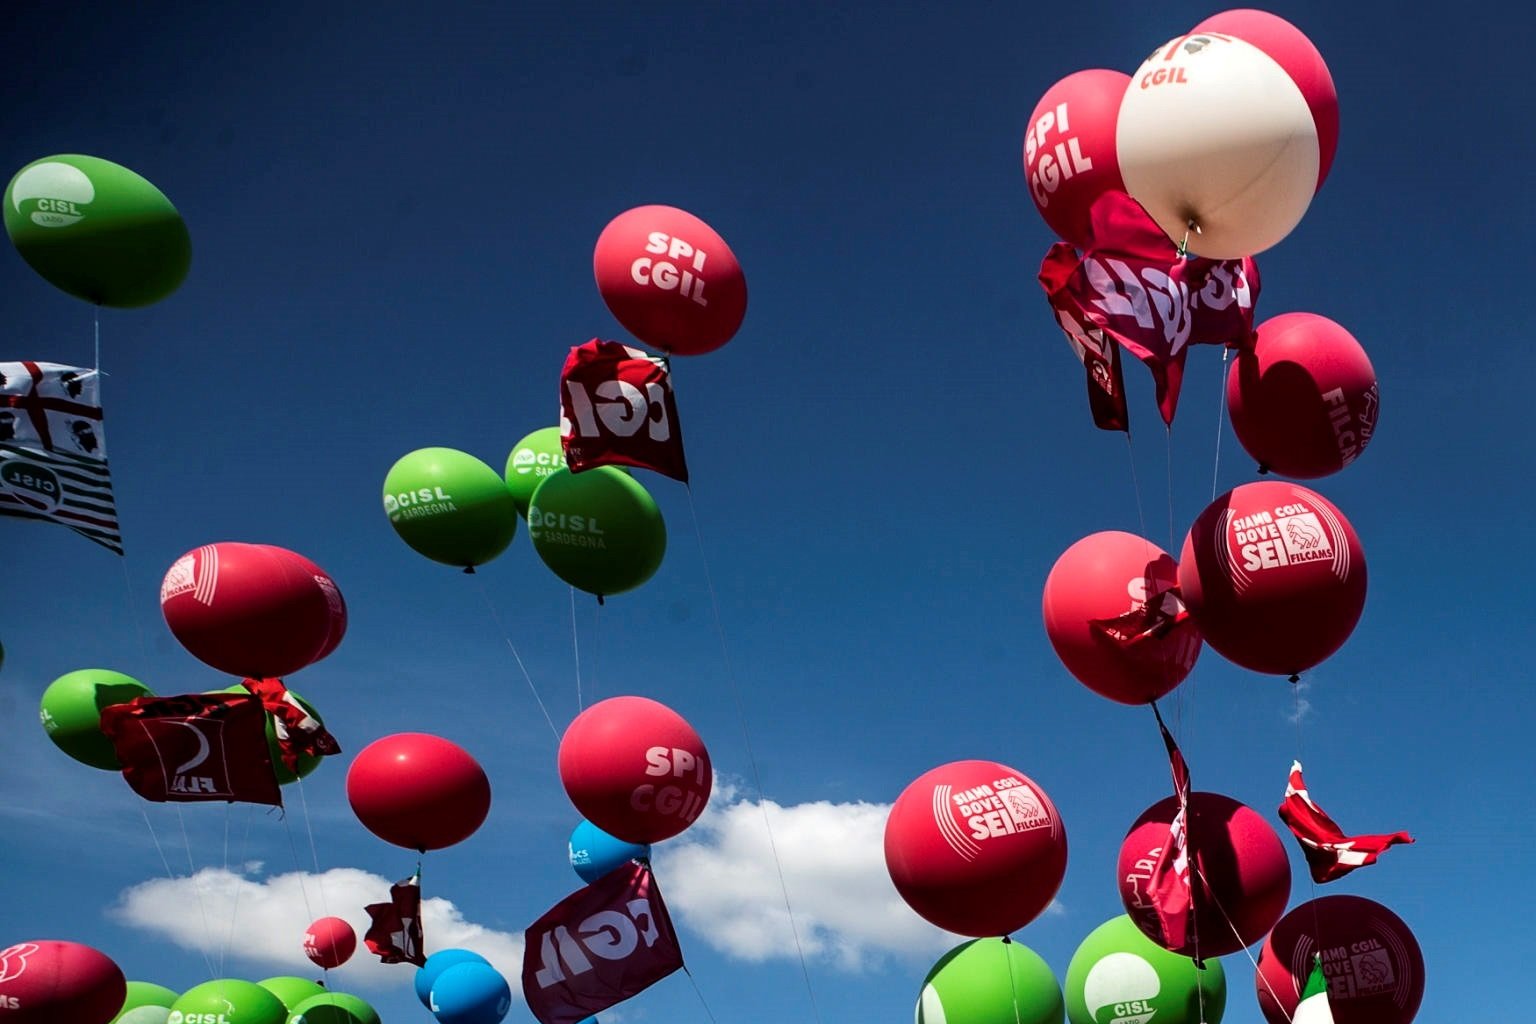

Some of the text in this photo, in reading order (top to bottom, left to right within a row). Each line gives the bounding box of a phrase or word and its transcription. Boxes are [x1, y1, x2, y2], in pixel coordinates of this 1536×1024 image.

[1140, 66, 1188, 90] CGIL
[1025, 102, 1070, 167] SPI
[1031, 137, 1093, 208] CGIL
[37, 199, 81, 216] CISL
[645, 231, 706, 273] SPI
[631, 258, 708, 307] CGIL
[1320, 387, 1358, 468] FILCA
[397, 487, 452, 507] CISL
[403, 503, 458, 520] SARDEGNA
[544, 512, 604, 534] CISL
[1233, 502, 1309, 532] SIAMO CGIL
[545, 531, 607, 549] SARDEGNA
[1236, 526, 1277, 545] DOVE
[1244, 539, 1288, 571] SEI
[1289, 547, 1333, 564] FILCAMS
[645, 746, 703, 787] SPI
[952, 774, 1022, 807] SIAMO CGIL
[960, 798, 1003, 819] DOVE
[971, 809, 1010, 841] SEI
[1016, 817, 1051, 834] FILCAMS
[1350, 939, 1382, 954] CGIL
[1114, 1000, 1154, 1018] CISL
